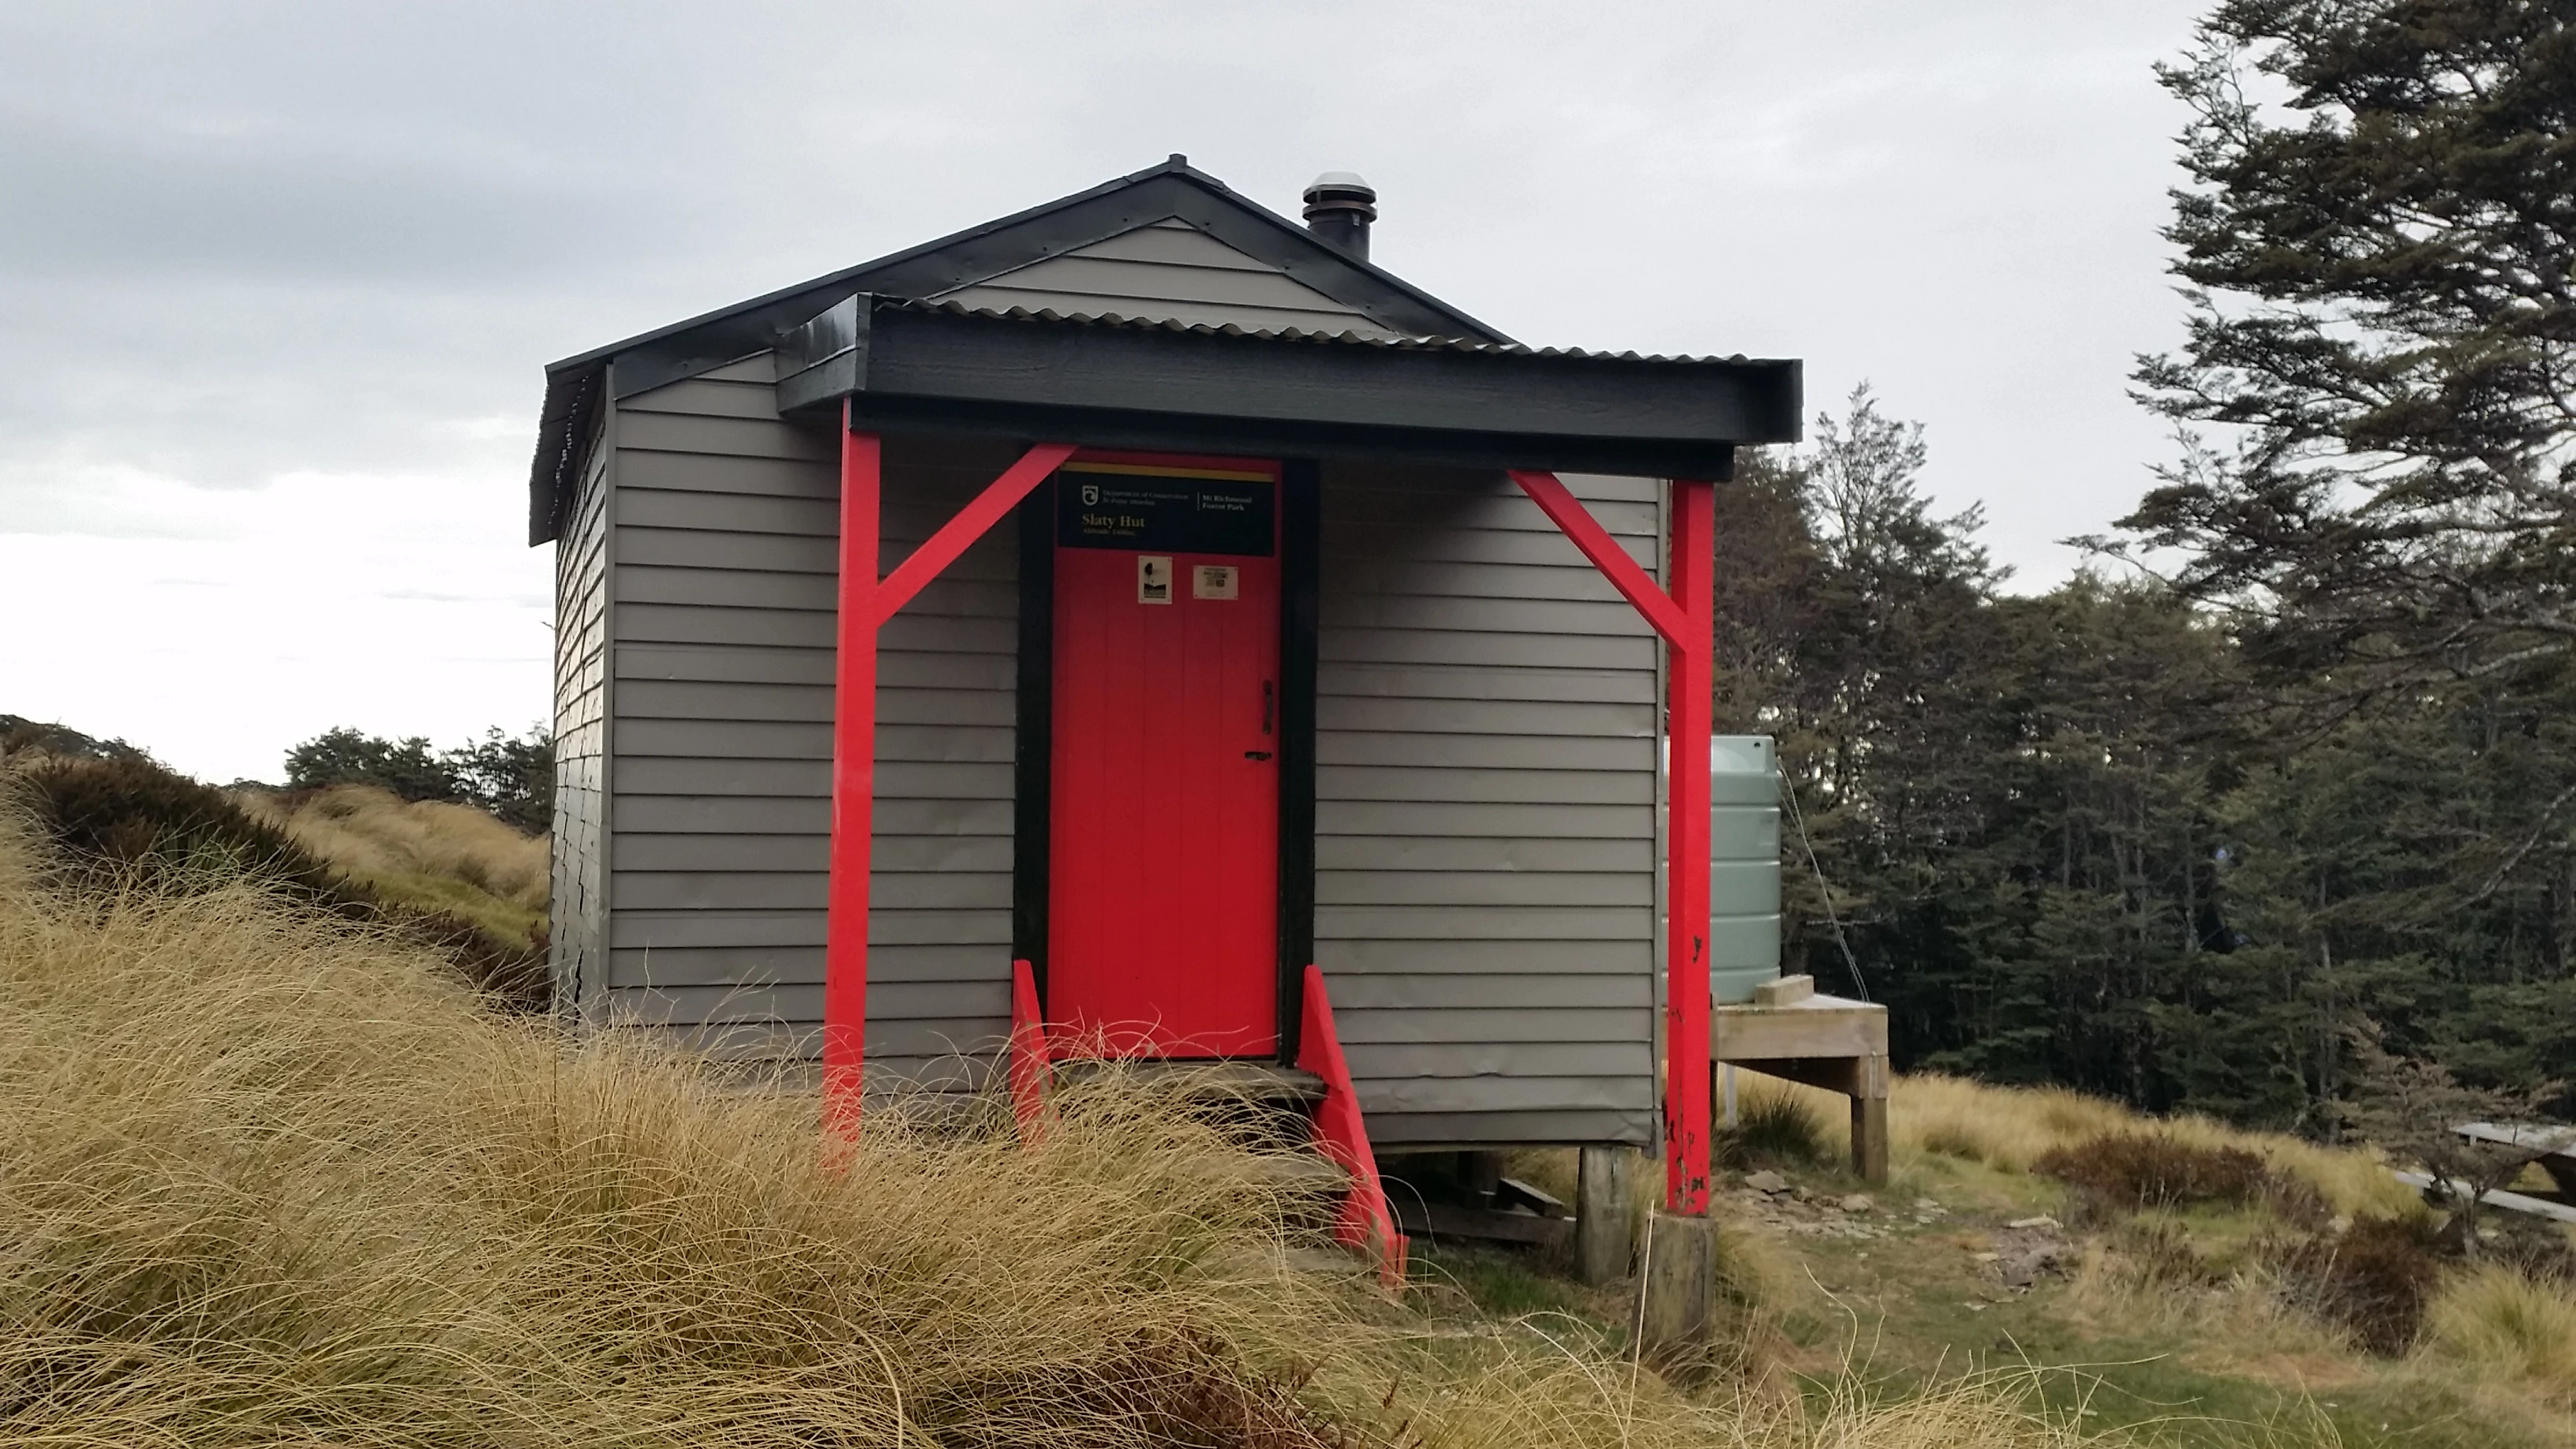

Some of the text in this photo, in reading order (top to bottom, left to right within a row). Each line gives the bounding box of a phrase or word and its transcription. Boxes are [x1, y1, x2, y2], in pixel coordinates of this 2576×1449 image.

[1214, 495, 1252, 504] Richmond
[1082, 513, 1145, 529] Slaty Hut
